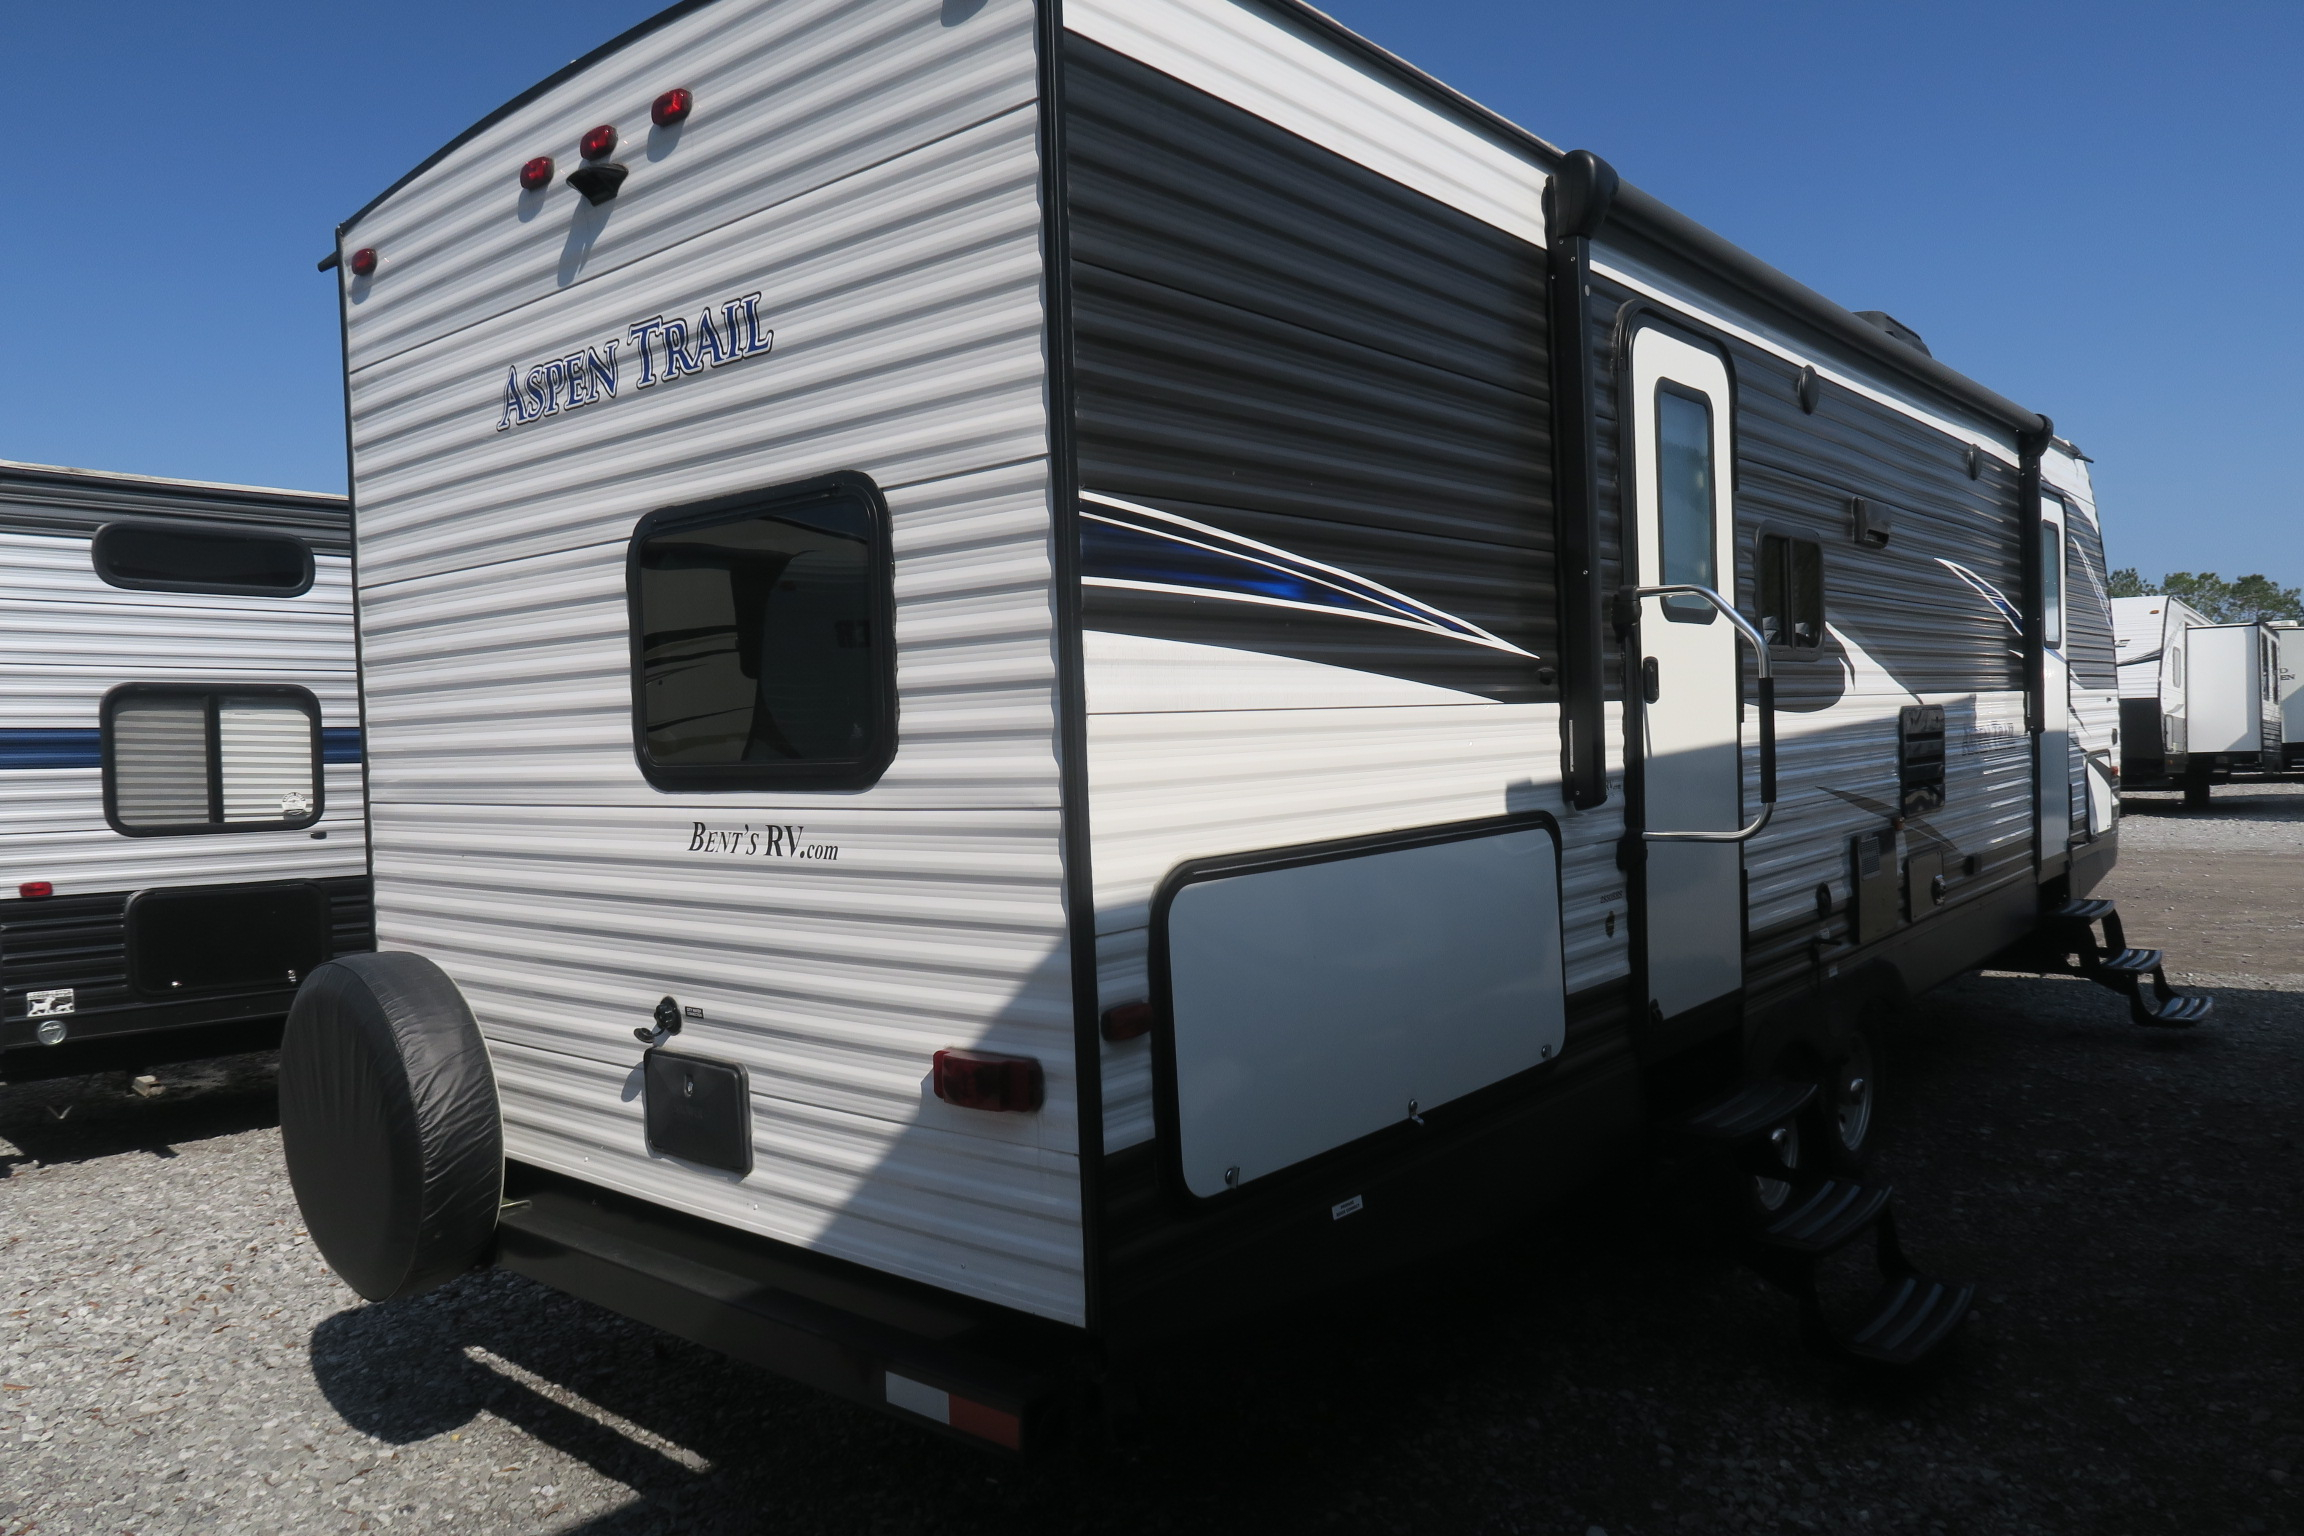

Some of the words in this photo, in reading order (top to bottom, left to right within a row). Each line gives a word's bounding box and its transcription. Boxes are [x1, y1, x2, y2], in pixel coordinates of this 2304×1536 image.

[496, 338, 620, 432] ASPEN
[626, 290, 775, 390] TRAIL
[764, 824, 839, 861] RV.com
